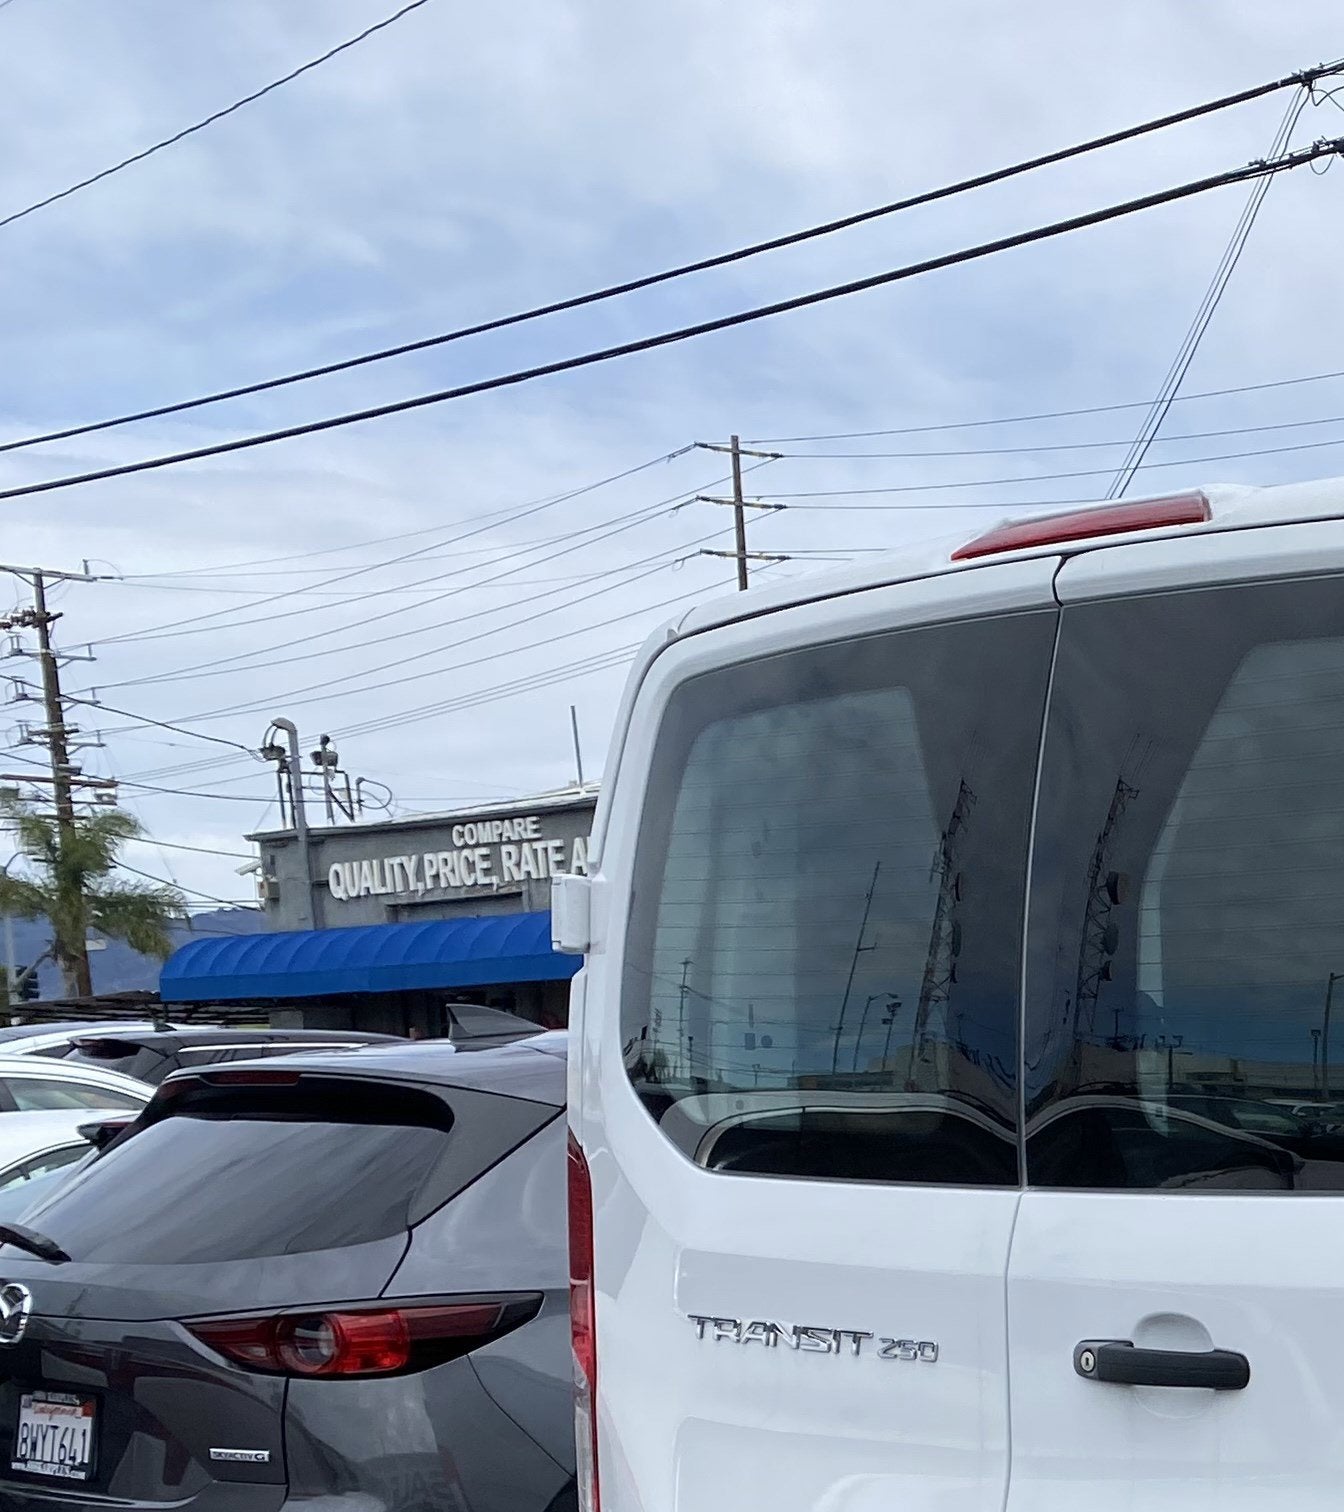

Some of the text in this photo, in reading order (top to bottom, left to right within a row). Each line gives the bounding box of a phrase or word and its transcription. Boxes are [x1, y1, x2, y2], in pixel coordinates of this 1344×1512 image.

[452, 816, 542, 847] COMPARE
[501, 839, 566, 883] RATE
[687, 1314, 939, 1363] TRANSIT 250
